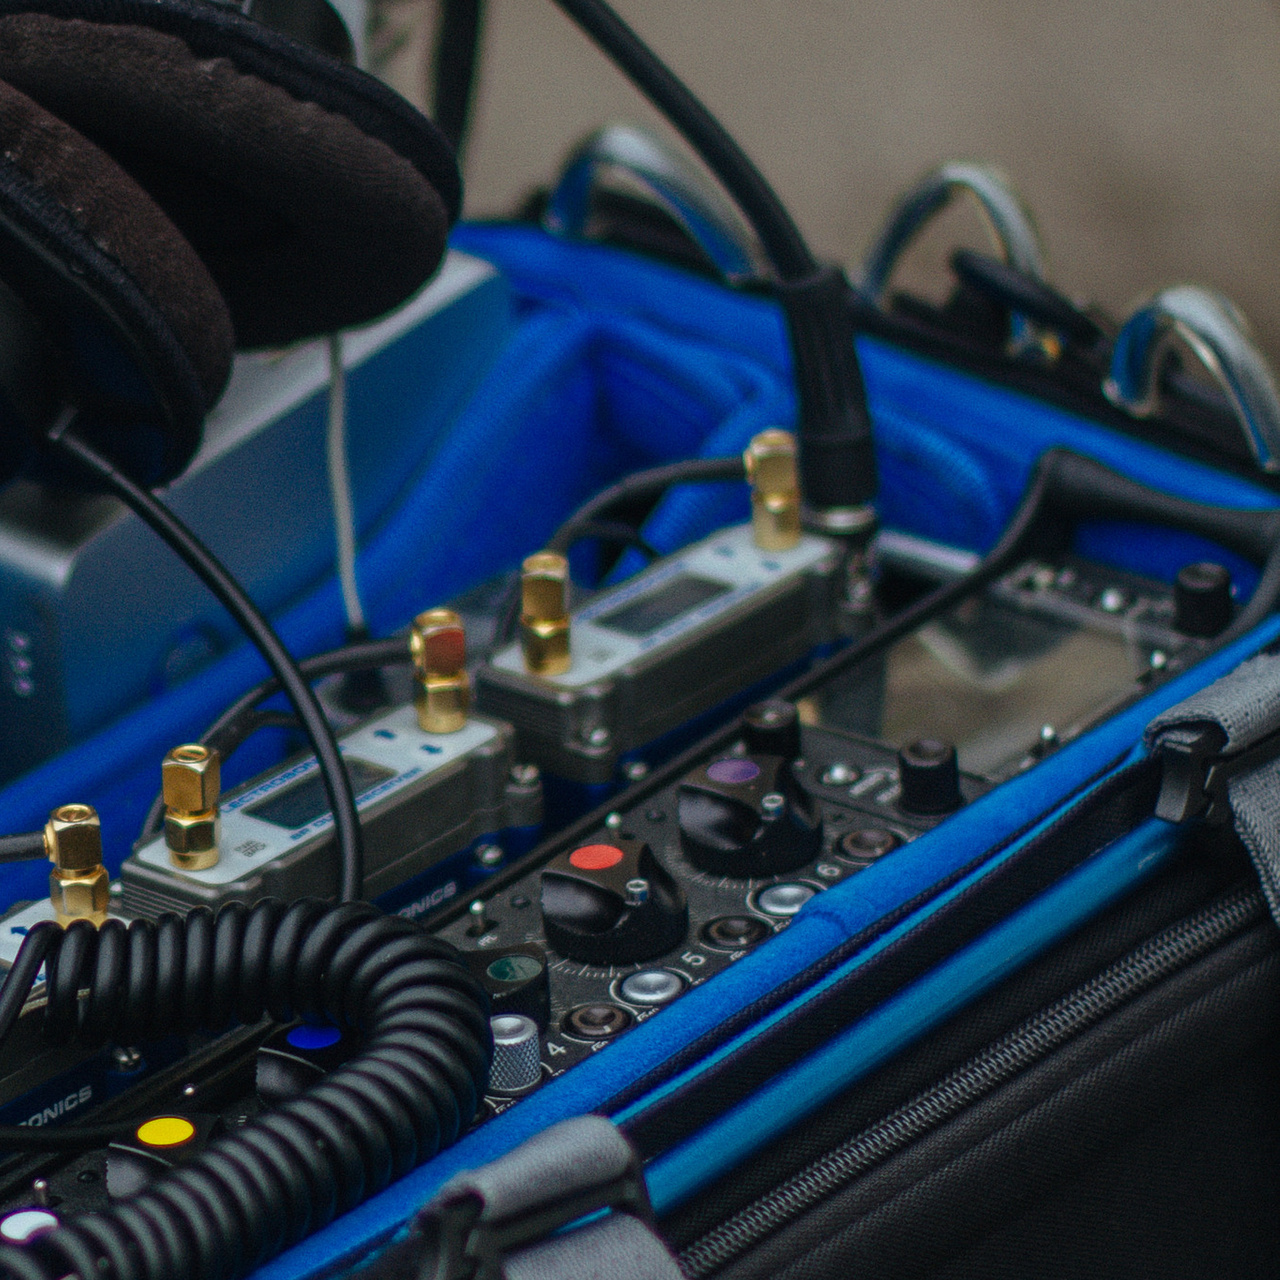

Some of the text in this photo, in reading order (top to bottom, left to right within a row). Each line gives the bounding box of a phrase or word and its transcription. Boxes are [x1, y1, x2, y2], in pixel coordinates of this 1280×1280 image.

[816, 864, 842, 878] 6
[681, 951, 707, 967] 5
[546, 1041, 568, 1058] 4
